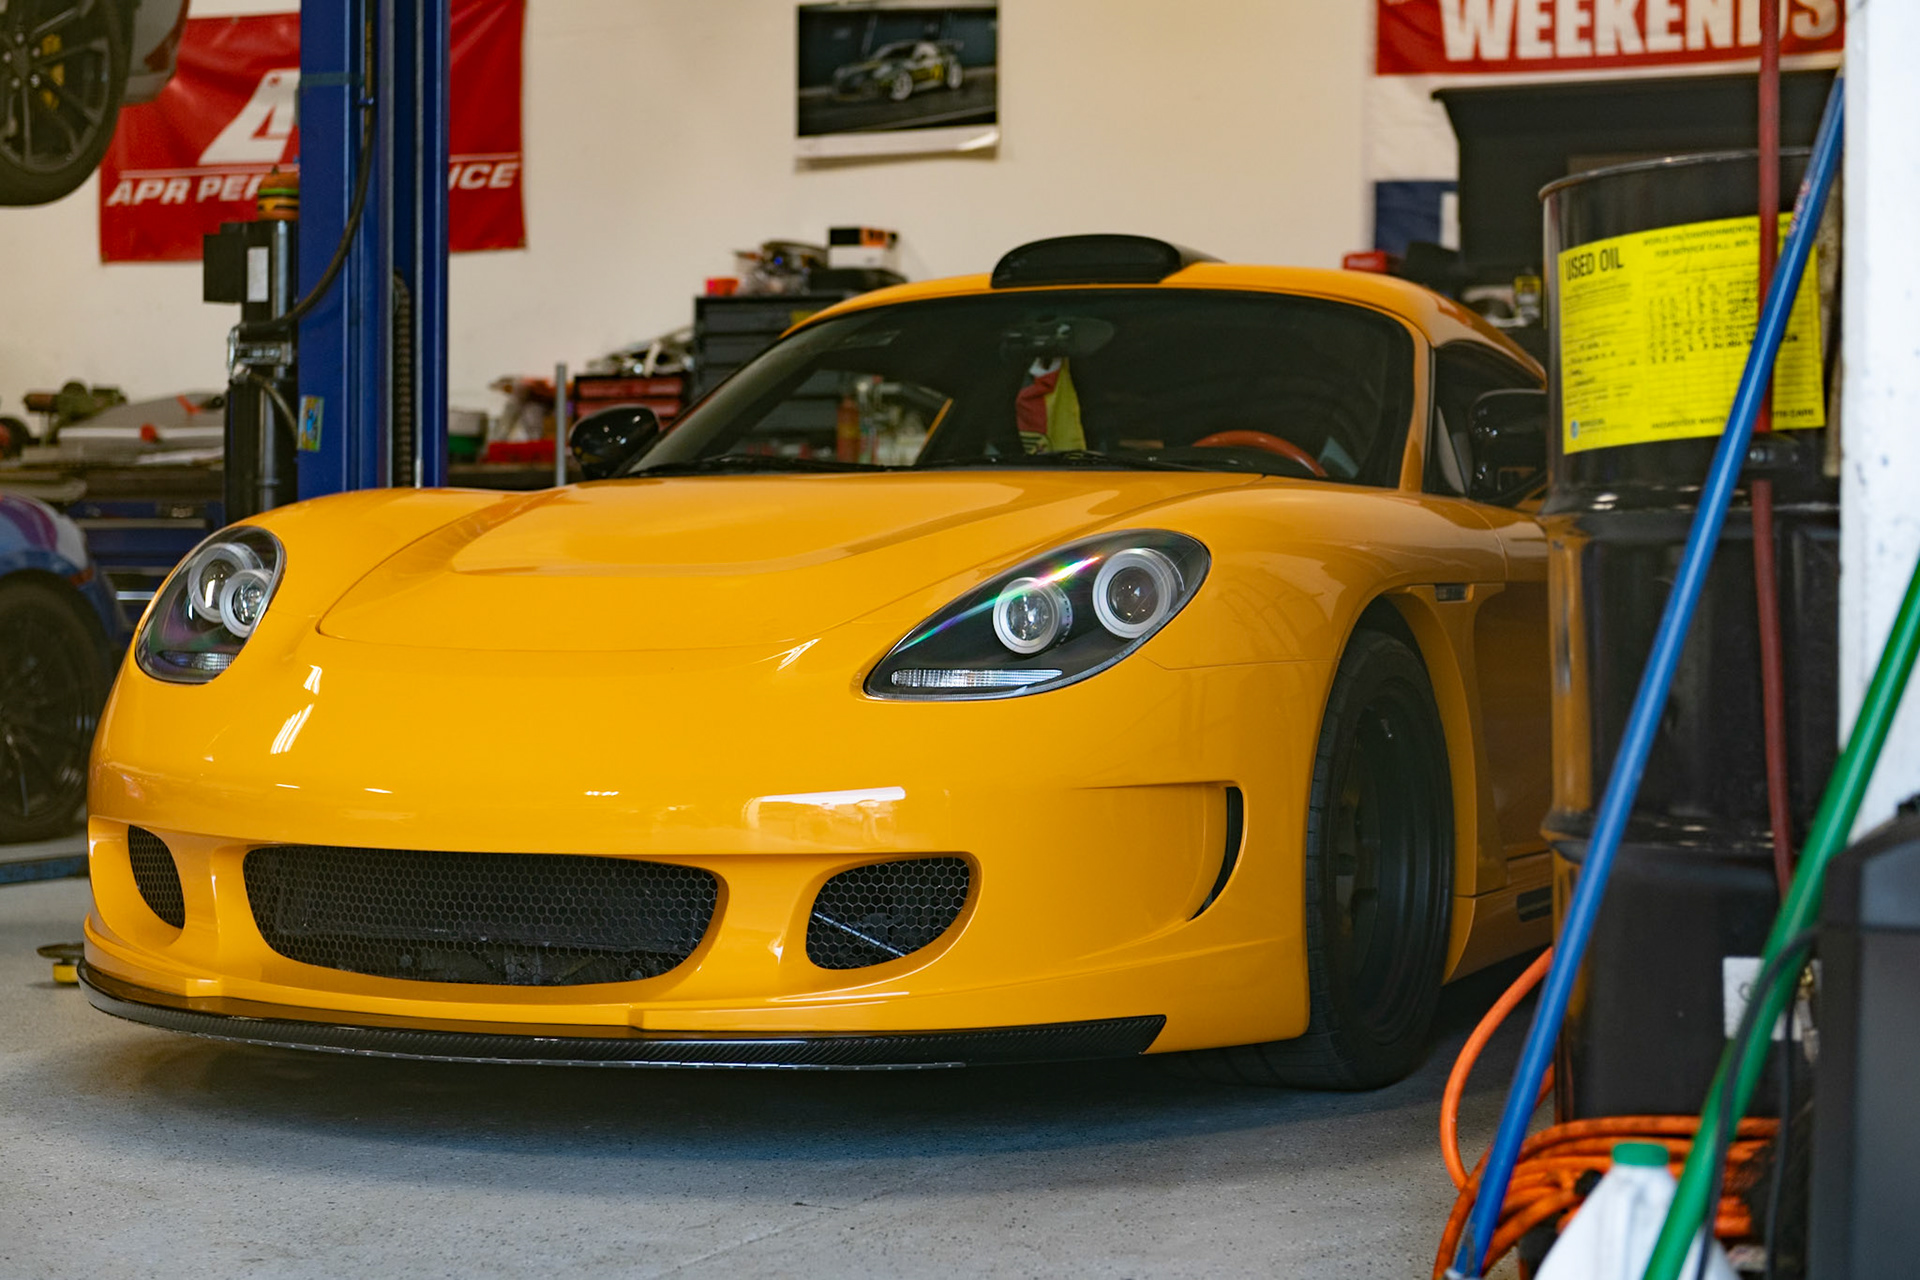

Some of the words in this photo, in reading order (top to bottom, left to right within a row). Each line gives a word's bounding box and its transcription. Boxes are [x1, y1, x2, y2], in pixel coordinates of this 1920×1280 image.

[104, 177, 191, 206] APR
[1565, 253, 1595, 281] USED
[1600, 247, 1624, 271] OIL
